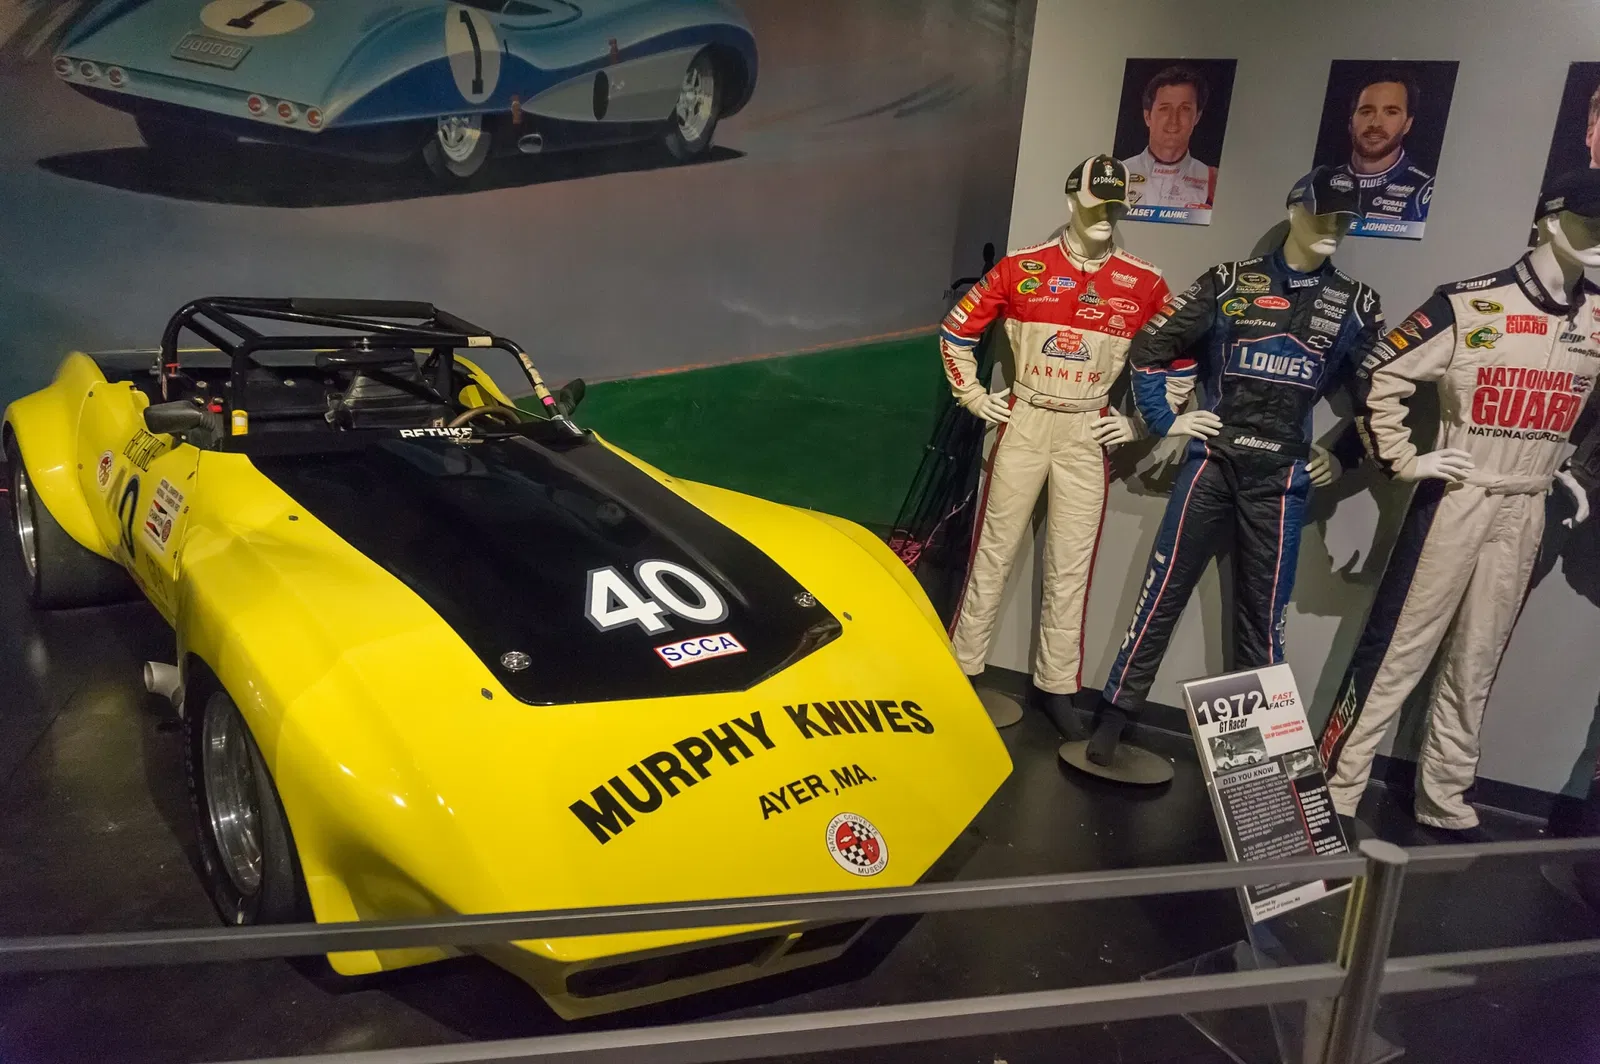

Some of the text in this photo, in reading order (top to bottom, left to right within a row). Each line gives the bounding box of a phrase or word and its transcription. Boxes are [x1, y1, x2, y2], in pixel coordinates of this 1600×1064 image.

[459, 9, 485, 95] 1
[1359, 174, 1388, 189] OWE'S
[1383, 199, 1408, 208] KOBALT
[1127, 207, 1189, 220] KASEY KAHNE
[1361, 222, 1408, 233] JOHNSON
[1289, 276, 1320, 288] LOWE'S
[1323, 303, 1347, 314] KOBALT
[1324, 310, 1343, 319] TOOLS
[1235, 319, 1276, 327] GOODYEAR
[1506, 321, 1548, 336] GUARD
[1239, 346, 1315, 380] LOWE'S
[1024, 364, 1102, 383] FARMERS
[1477, 367, 1574, 392] NATIONAL
[1471, 386, 1582, 433] GUARD
[1234, 435, 1281, 452] Johnson
[584, 558, 729, 636] 40
[661, 636, 738, 662] SCCA
[1268, 698, 1295, 710] FACTS
[1272, 691, 1294, 701] FAST
[1197, 690, 1263, 725] 1972
[1219, 718, 1248, 733] GT Racer
[568, 700, 934, 845] MURPHY KNIVES
[1222, 766, 1275, 785] DID YOU KNOW
[828, 814, 878, 852] NATIONAL CORVETTE
[857, 857, 885, 875] MUSEUM
